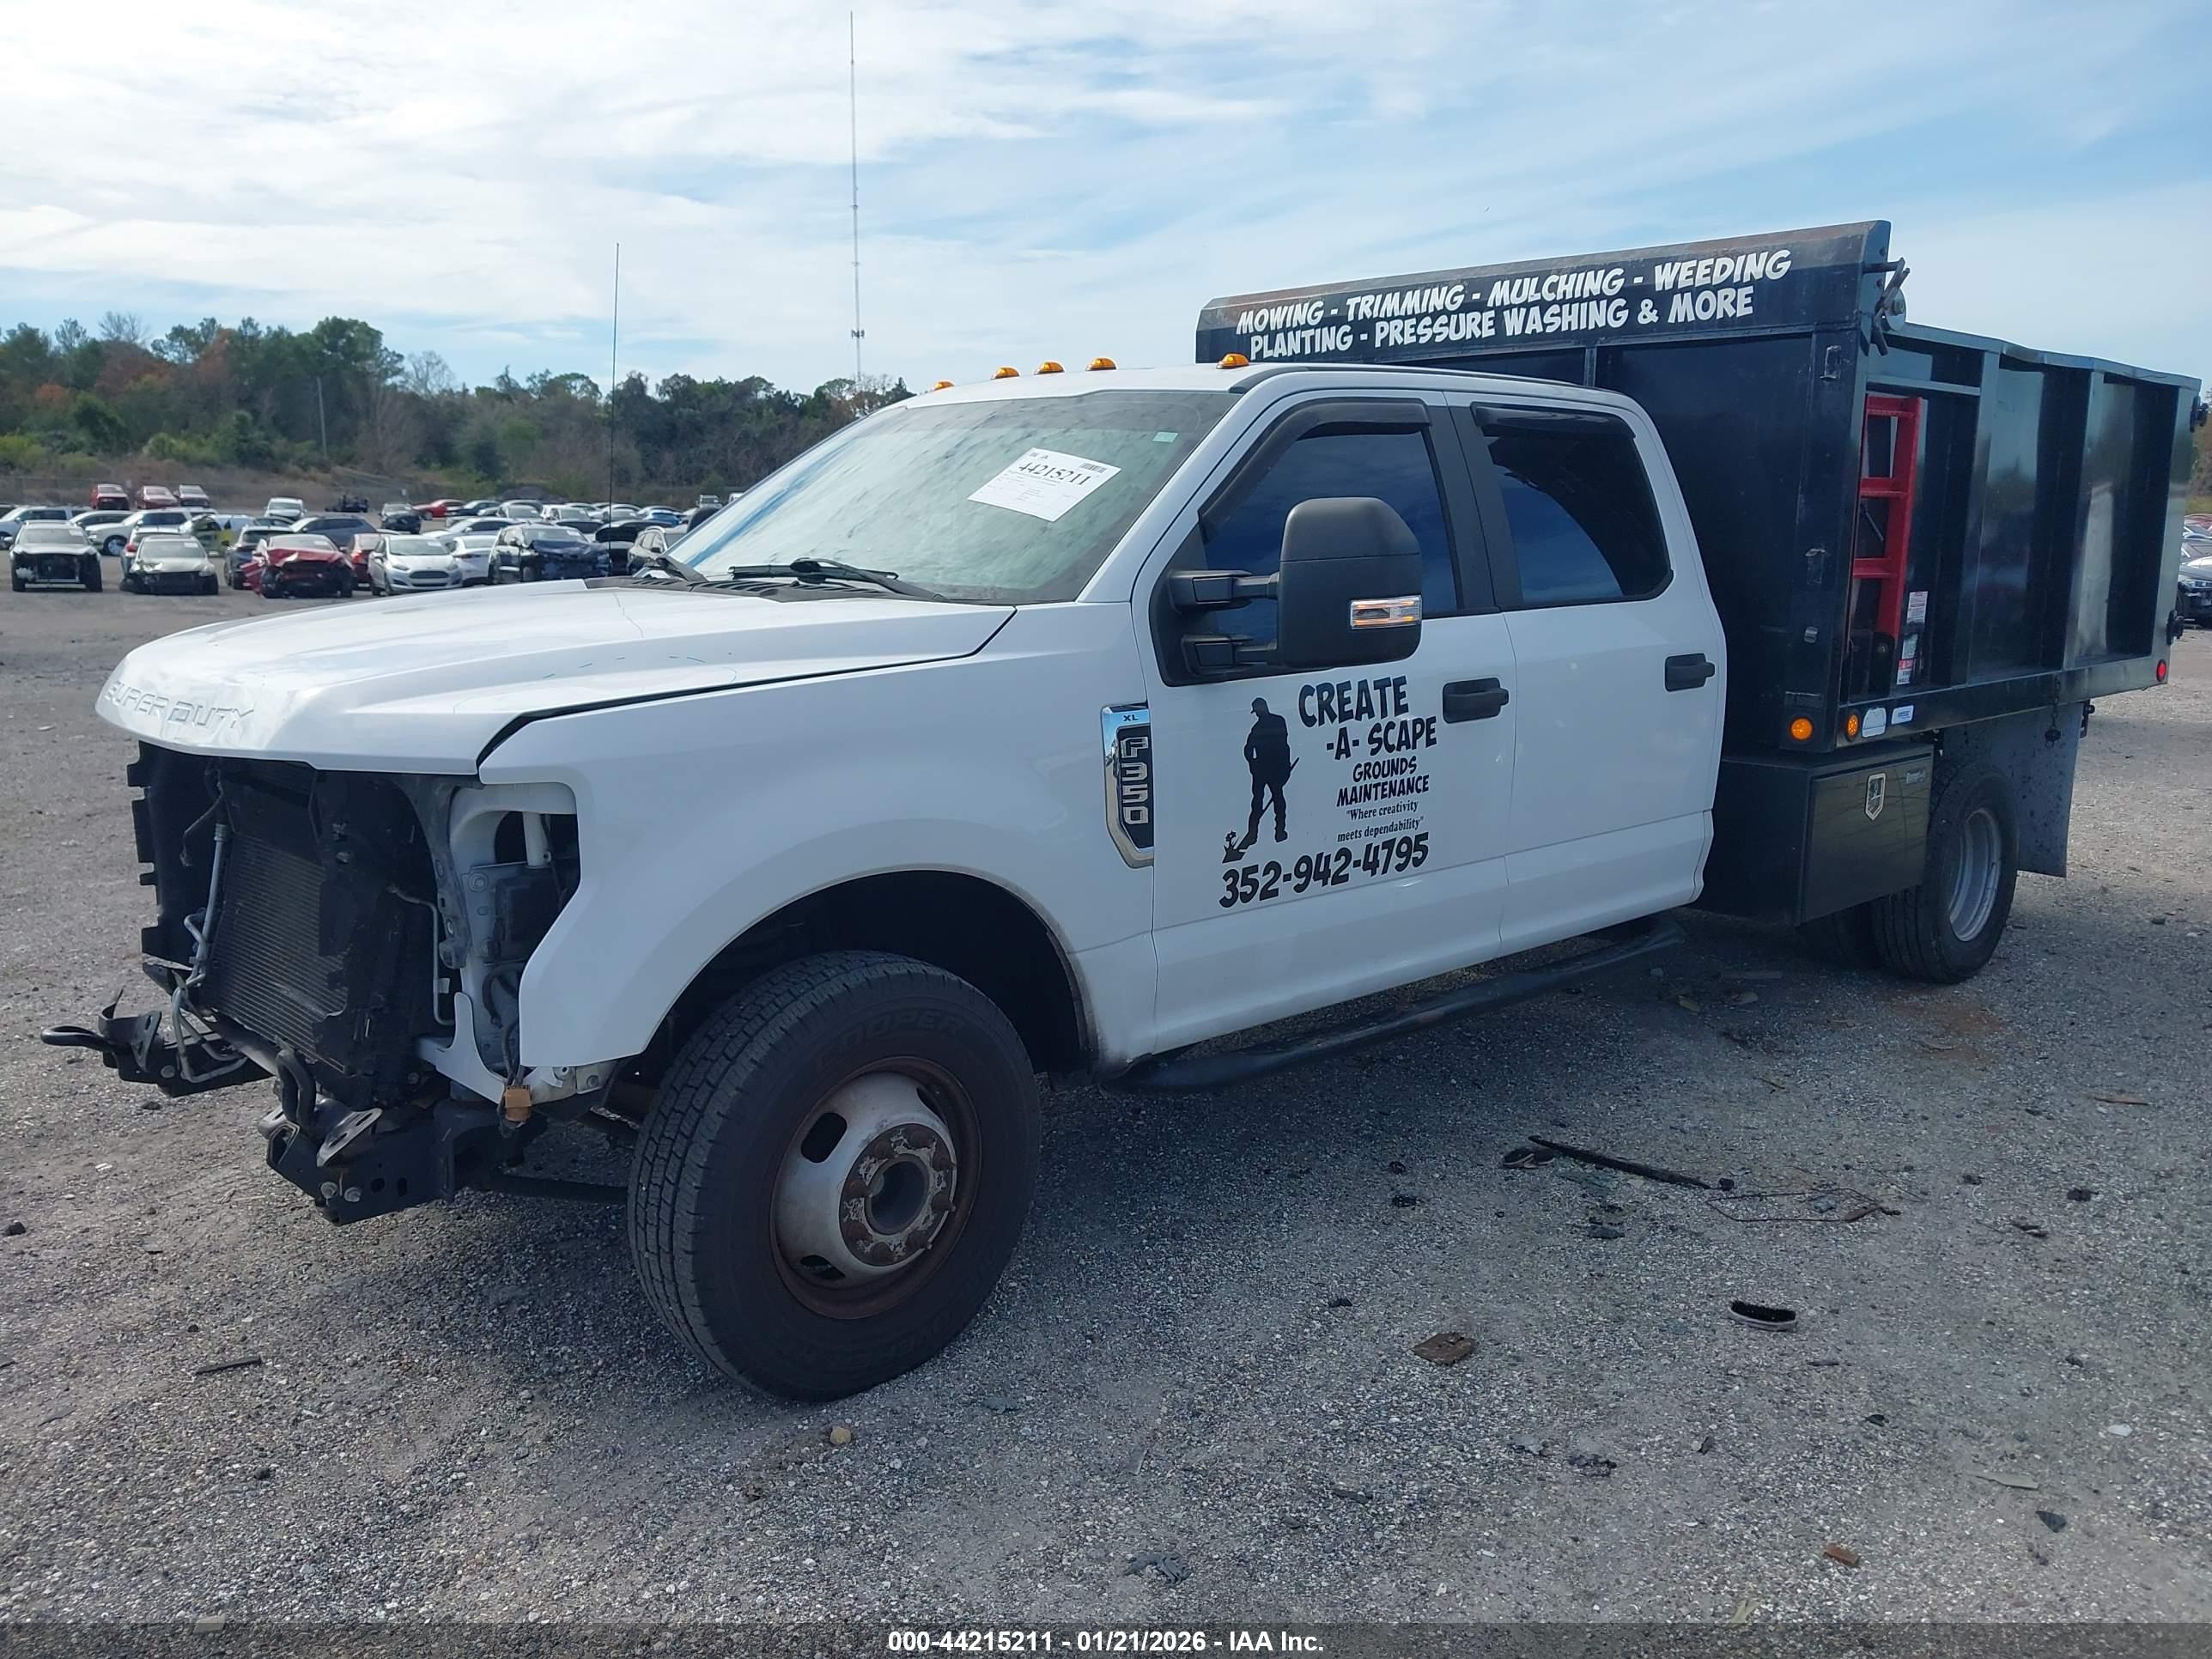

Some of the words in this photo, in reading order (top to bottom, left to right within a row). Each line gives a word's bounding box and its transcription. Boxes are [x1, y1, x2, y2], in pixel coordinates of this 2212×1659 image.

[1237, 301, 1323, 335] MOWING
[1346, 284, 1465, 323] TRIMMING
[1486, 267, 1626, 307] MULCHING
[1654, 250, 1792, 292] WEEDING
[1249, 325, 1352, 361] PLANTING
[1376, 309, 1496, 348] PRESSURE
[1503, 297, 1627, 337] WASHING
[1638, 299, 1660, 325] &
[1668, 286, 1753, 325] MORE
[1018, 461, 1091, 485] 44215211
[105, 681, 169, 718] SUPER
[167, 701, 254, 728] DUTY
[1123, 714, 1139, 722] XL
[1298, 675, 1409, 728] CREATE
[1367, 716, 1437, 757] SCAPE
[1120, 736, 1149, 825] F350
[1352, 756, 1417, 782] GROUNDS
[1336, 775, 1429, 807] MAINTENANCE
[1378, 800, 1419, 817] creativity
[1337, 826, 1362, 842] meets
[1218, 831, 1429, 908] 352-942-4795
